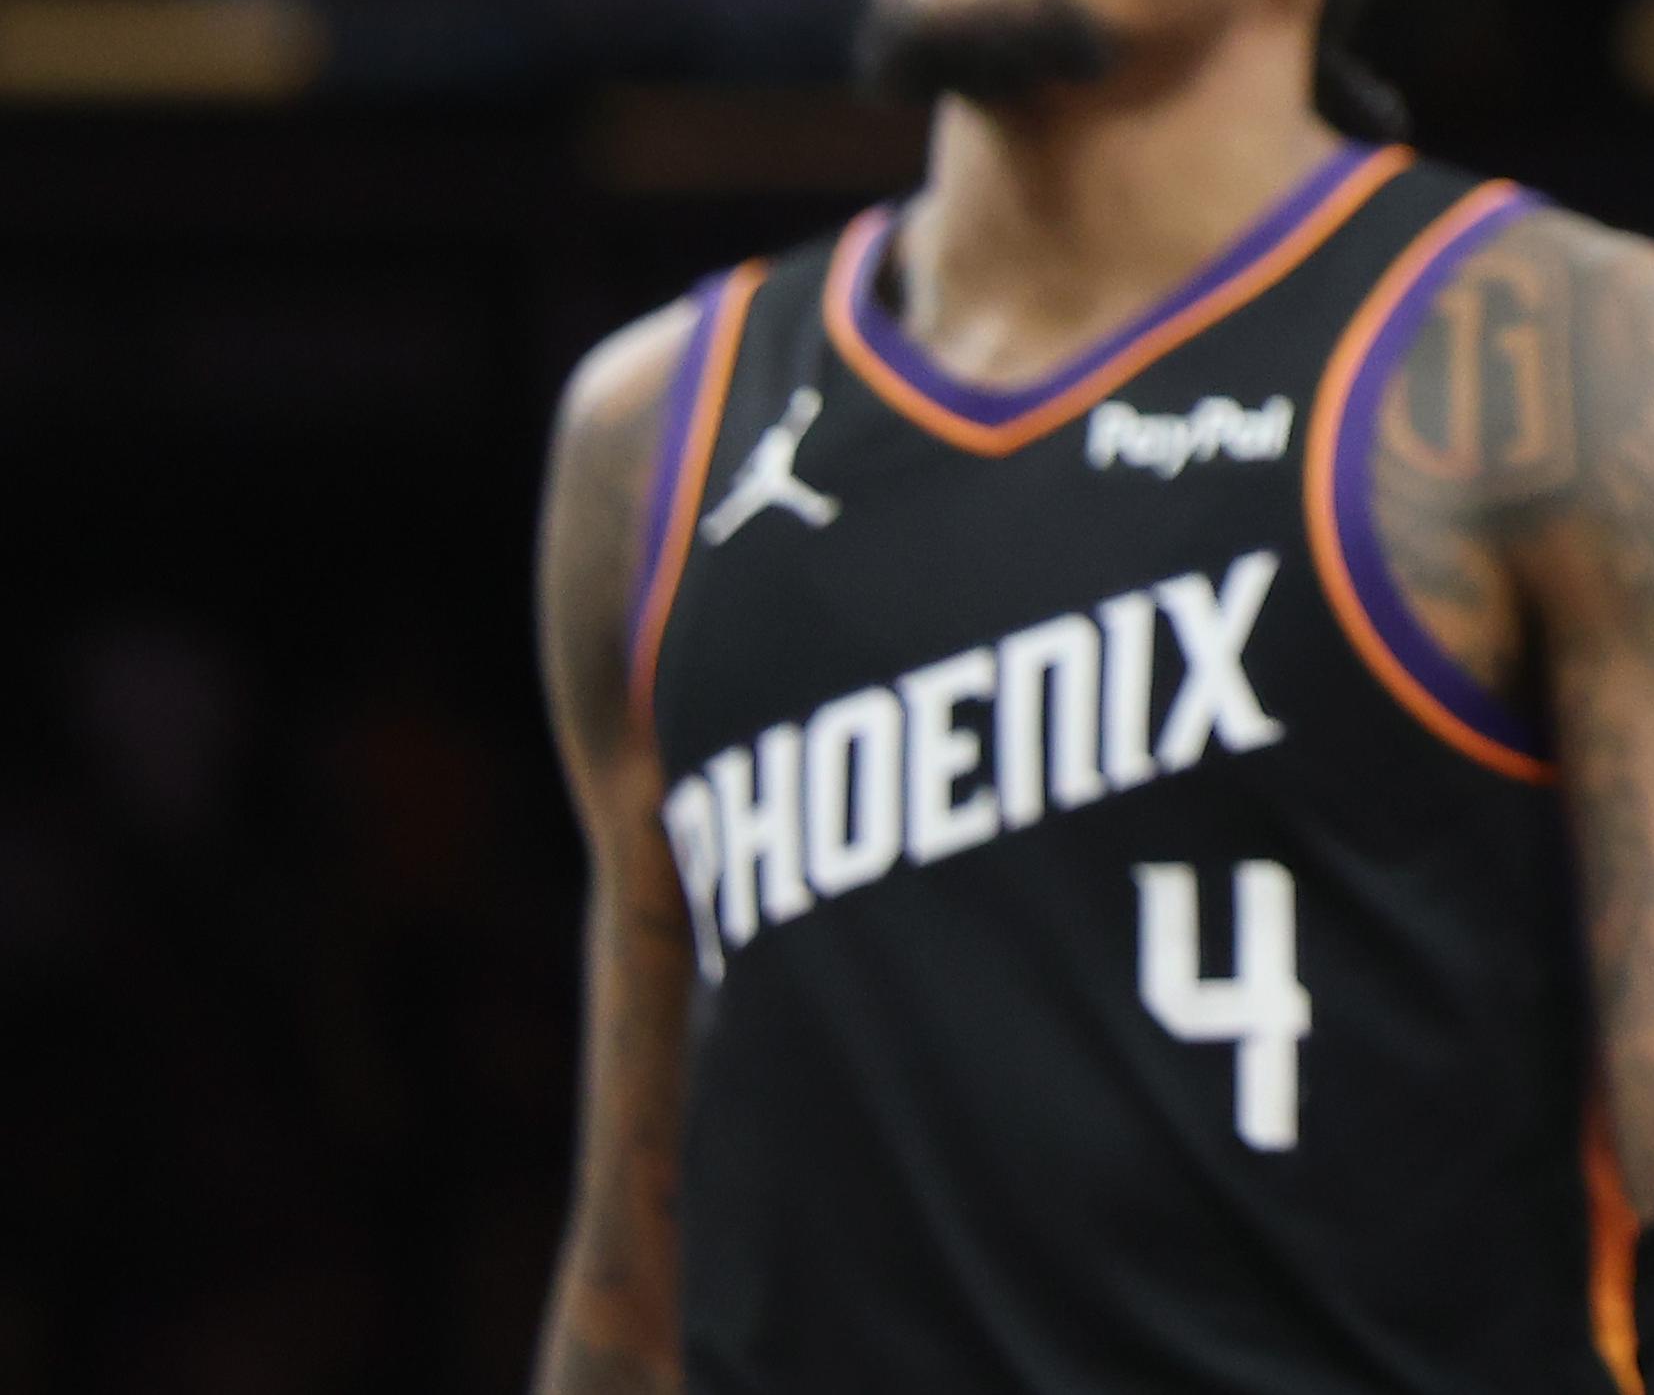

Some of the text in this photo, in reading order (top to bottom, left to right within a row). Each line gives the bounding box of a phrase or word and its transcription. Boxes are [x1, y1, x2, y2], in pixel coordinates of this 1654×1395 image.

[1086, 395, 1294, 480] PayPal
[662, 549, 1286, 985] PHOENIX
[1132, 860, 1310, 1150] 4
